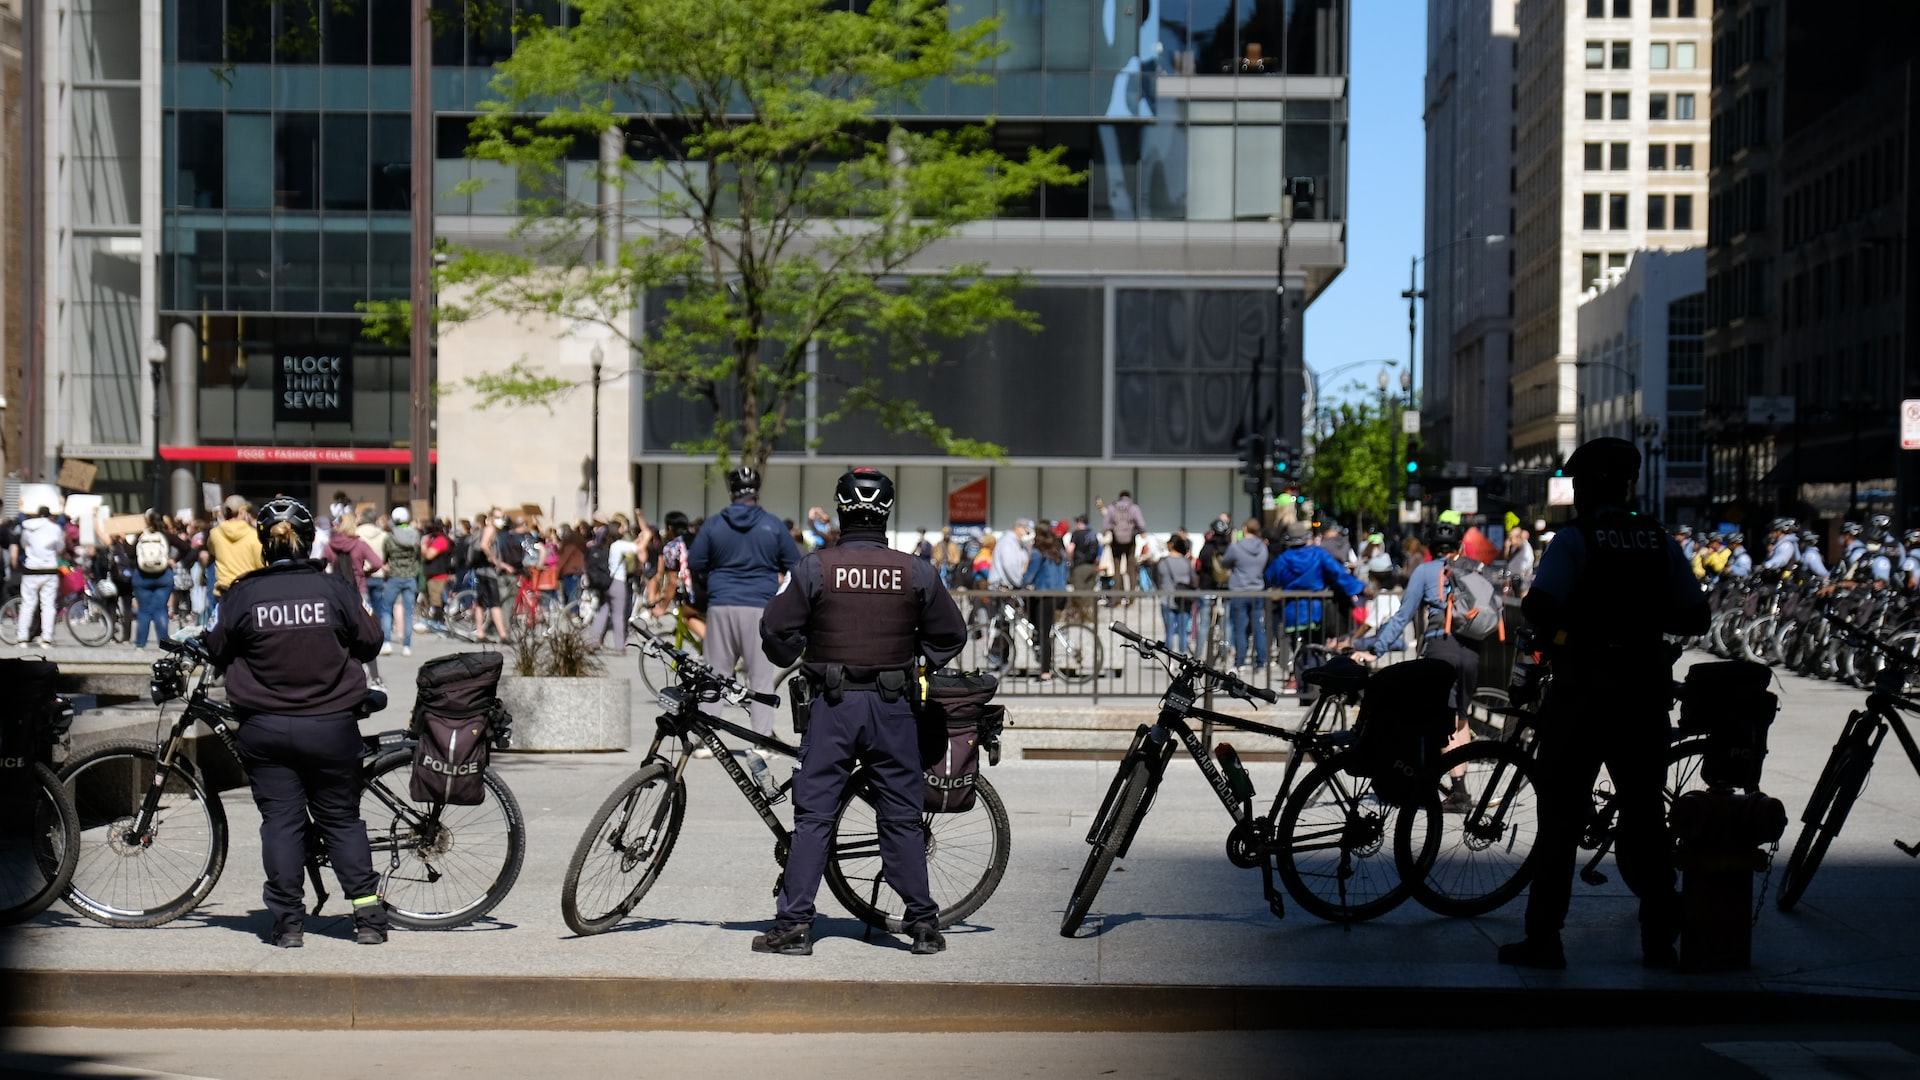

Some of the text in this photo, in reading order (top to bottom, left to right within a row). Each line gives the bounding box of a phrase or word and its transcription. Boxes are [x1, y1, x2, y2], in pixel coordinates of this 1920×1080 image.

[283, 356, 341, 373] BLOCK
[284, 374, 341, 390] THIRTY
[283, 391, 338, 409] SEVEN
[237, 449, 354, 461] FOOD FASHION FILMS
[1596, 529, 1660, 549] POLICE
[836, 568, 902, 590] POLICE
[257, 603, 326, 627] POLICE
[423, 755, 478, 775] POLICE
[704, 734, 741, 779] CHICAGO
[738, 777, 769, 817] POLICE
[1213, 775, 1240, 811] POLICE
